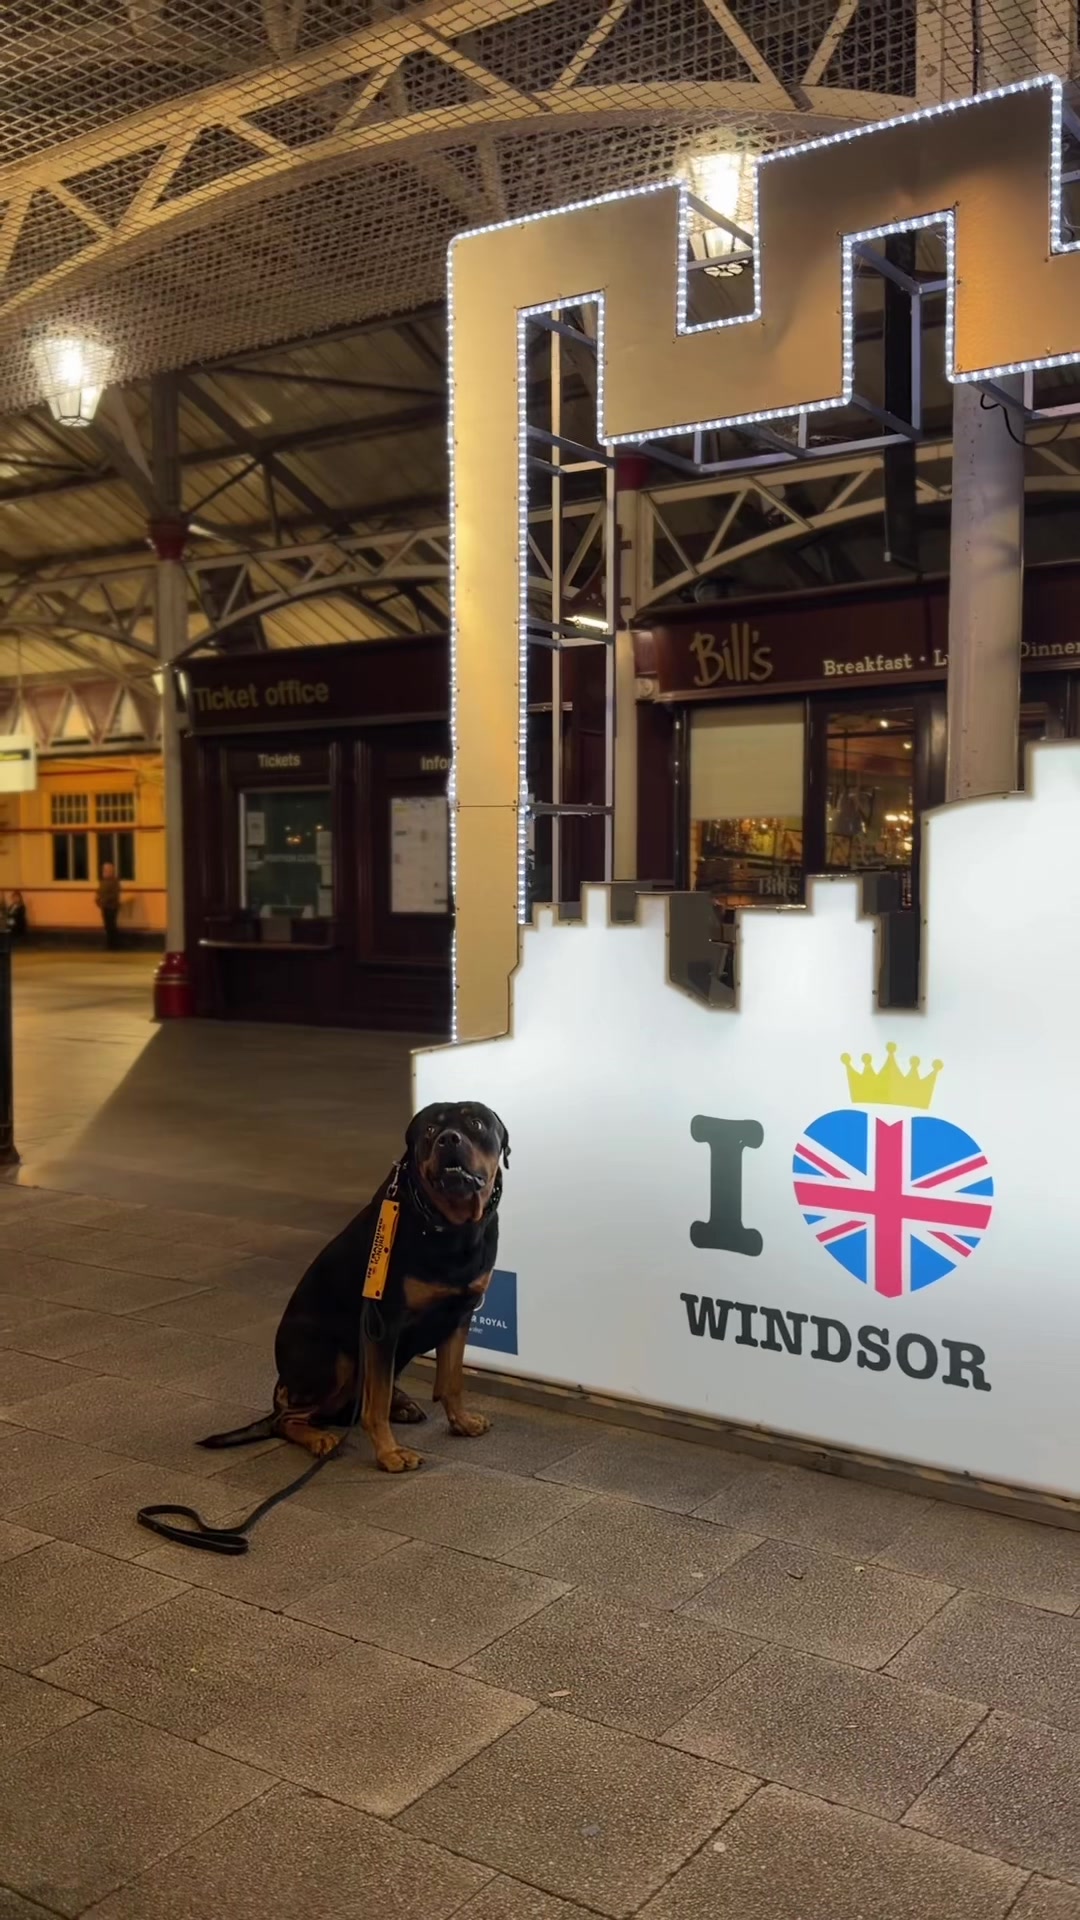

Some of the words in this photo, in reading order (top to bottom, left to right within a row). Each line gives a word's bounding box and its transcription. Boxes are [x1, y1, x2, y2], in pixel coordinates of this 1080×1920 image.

[690, 621, 773, 687] Bill's
[823, 654, 913, 675] Breakfast
[192, 683, 259, 711] Ticket
[265, 679, 329, 706] office
[258, 754, 301, 768] Tickets
[690, 1114, 764, 1257] I
[479, 1316, 508, 1329] ROYAL
[680, 1292, 992, 1392] WINDSOR
